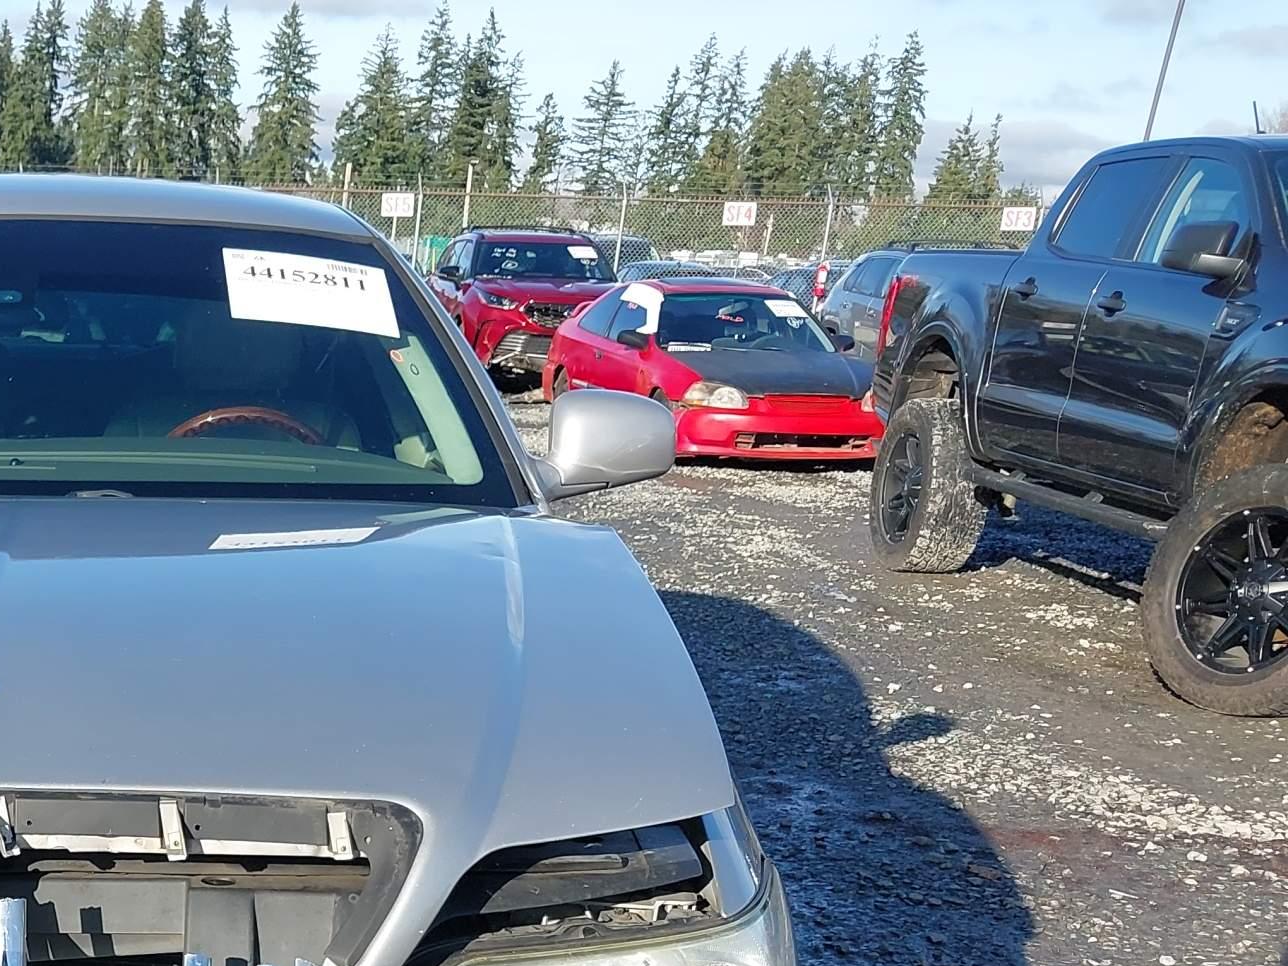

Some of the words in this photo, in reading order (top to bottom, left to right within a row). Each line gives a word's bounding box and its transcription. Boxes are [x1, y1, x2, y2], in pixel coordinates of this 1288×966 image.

[726, 205, 753, 222] SF4
[1004, 210, 1033, 227] SF3
[243, 265, 366, 291] 44152811
